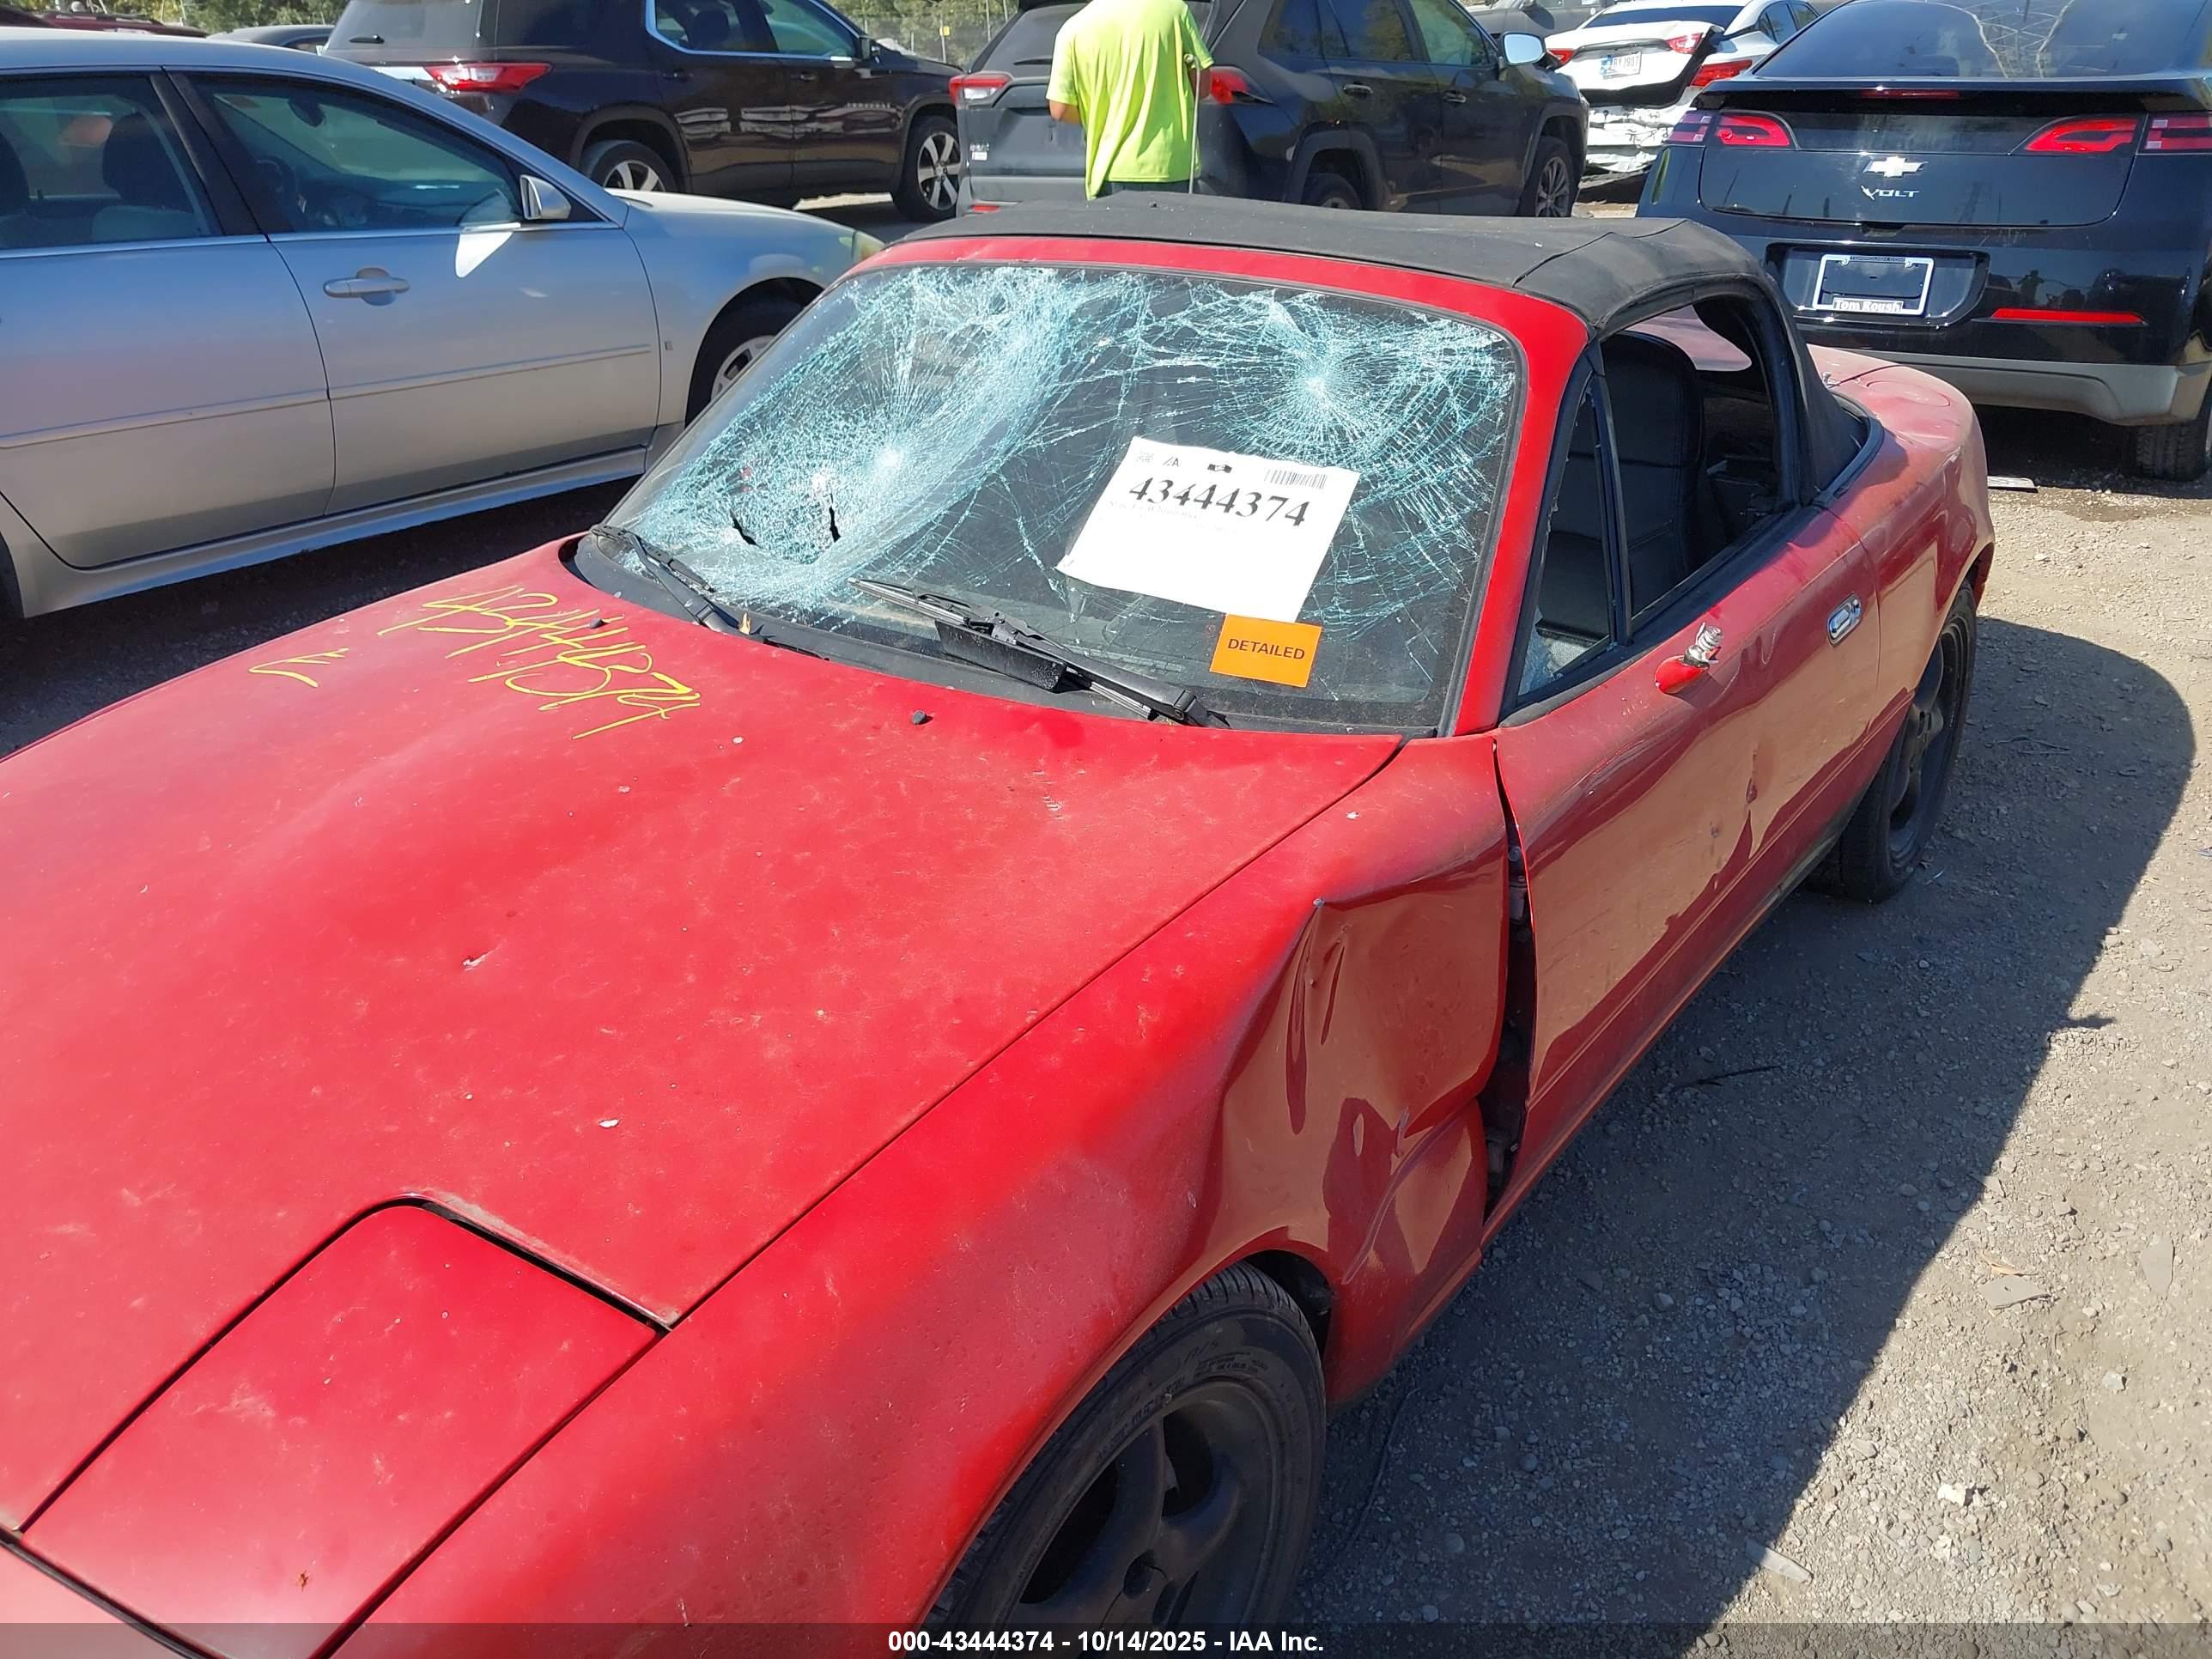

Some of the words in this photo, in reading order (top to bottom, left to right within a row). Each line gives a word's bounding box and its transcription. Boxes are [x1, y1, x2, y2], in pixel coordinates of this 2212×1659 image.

[1860, 185, 1920, 201] VOLT
[1835, 300, 1861, 311] Tom
[1862, 301, 1901, 313] Roush
[1128, 477, 1311, 527] 43444374
[1227, 637, 1306, 660] DETAILED
